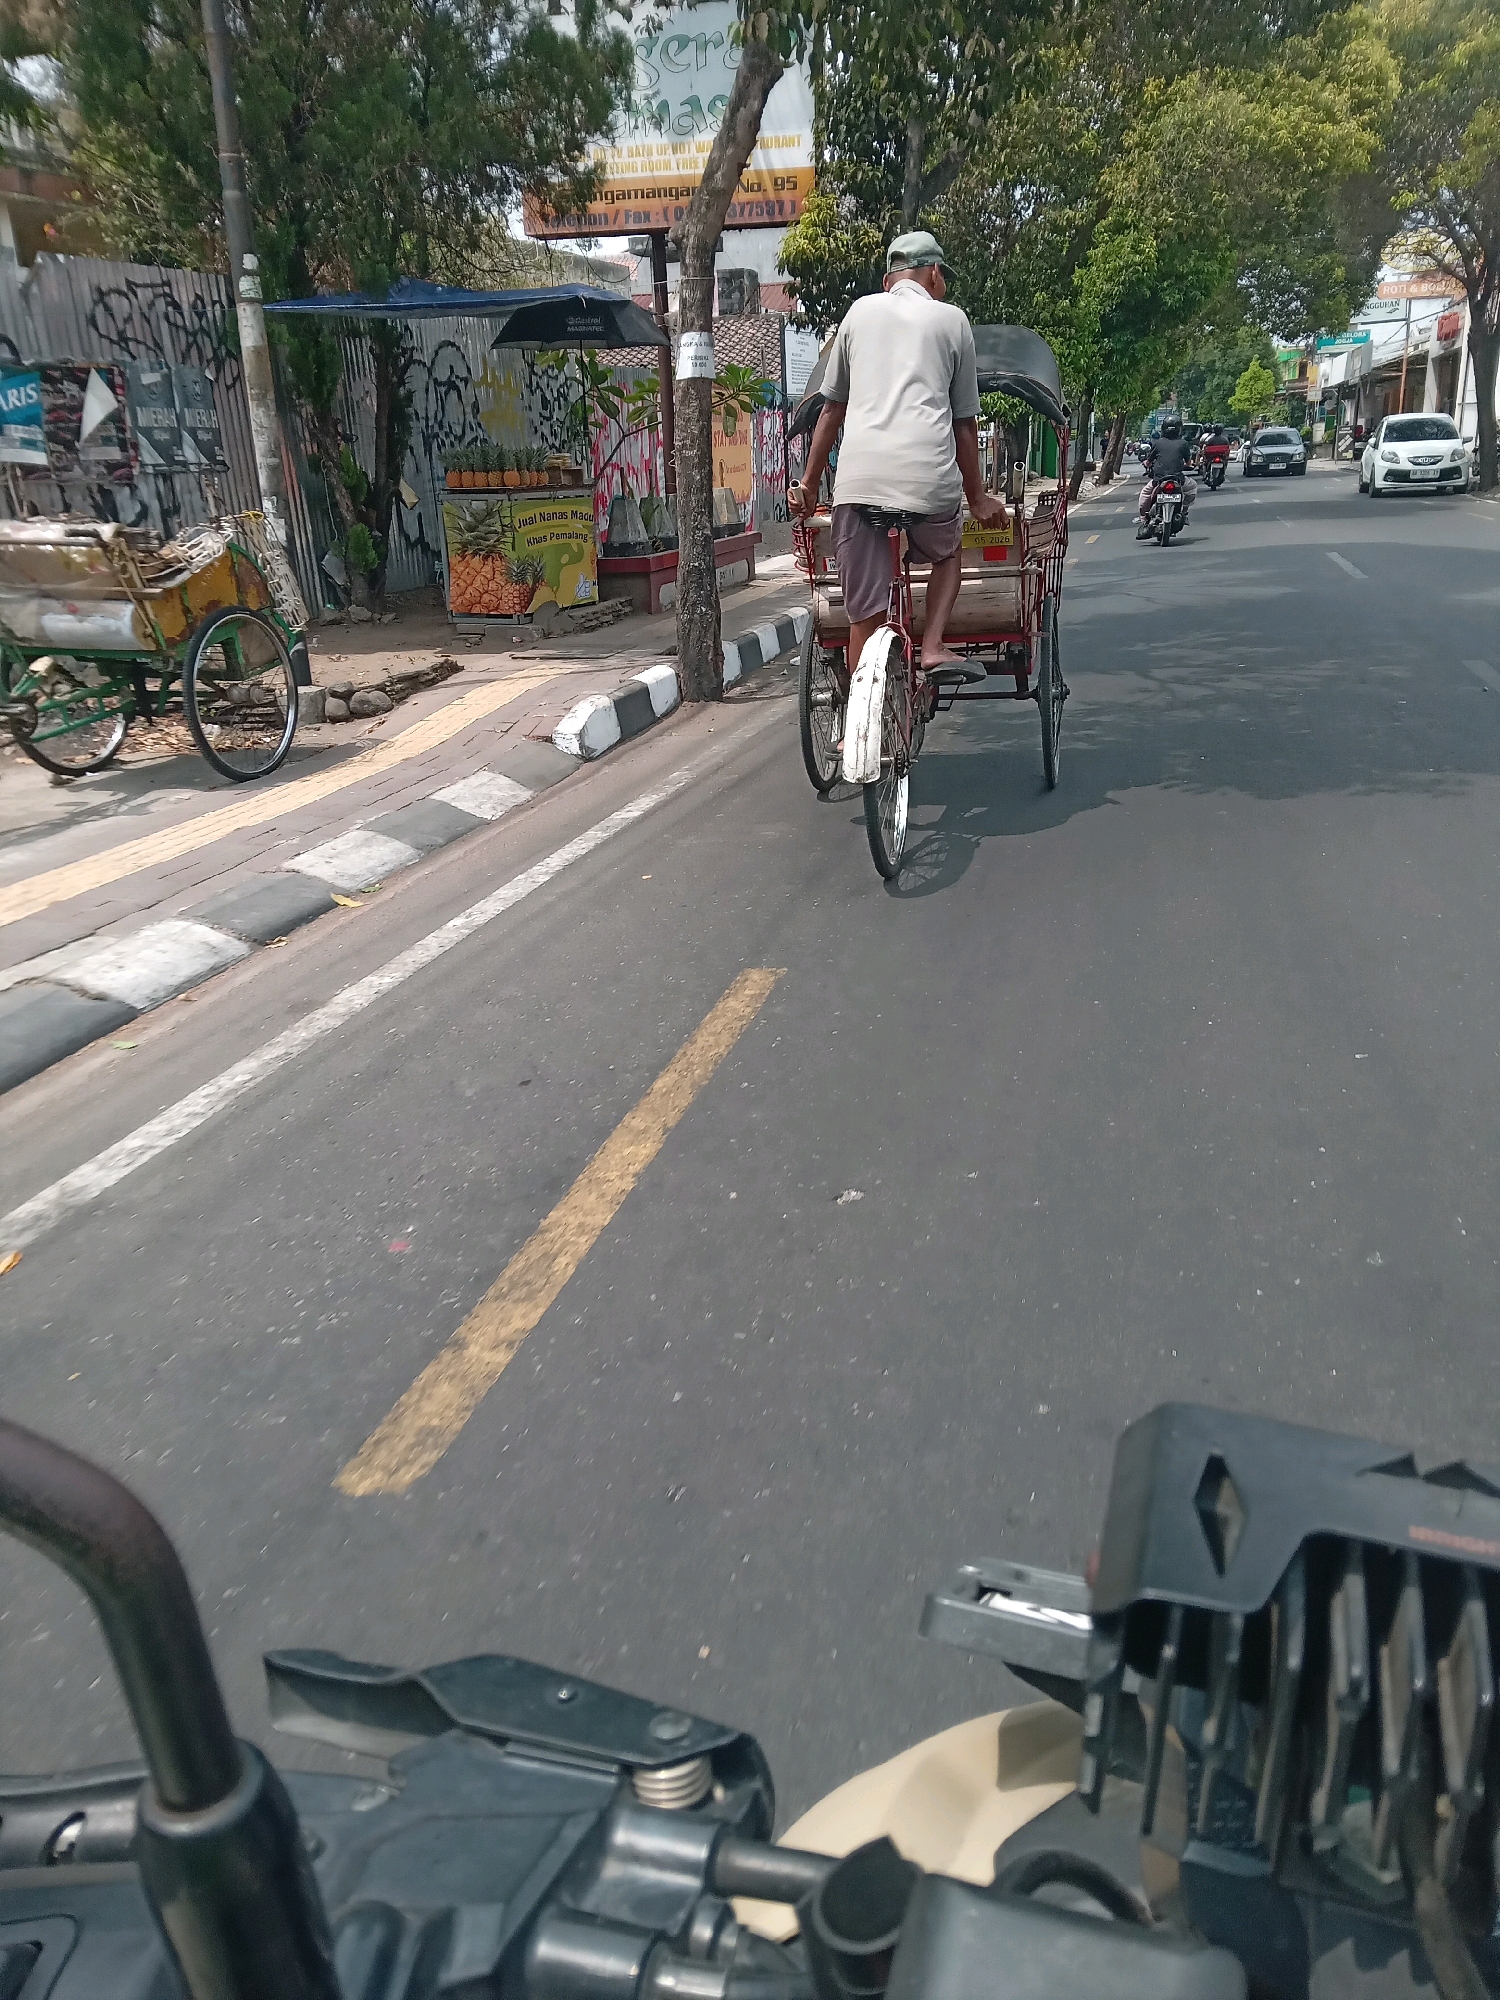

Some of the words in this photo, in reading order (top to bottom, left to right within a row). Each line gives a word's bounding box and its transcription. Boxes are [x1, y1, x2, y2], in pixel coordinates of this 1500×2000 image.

[773, 175, 798, 191] 95
[1382, 284, 1407, 295] ROTI
[517, 512, 538, 529] Jual
[539, 511, 568, 523] Nanas
[570, 509, 594, 522] Madu
[526, 534, 548, 547] Khas
[549, 530, 589, 543] Pemalang
[989, 535, 1010, 544] 2026
